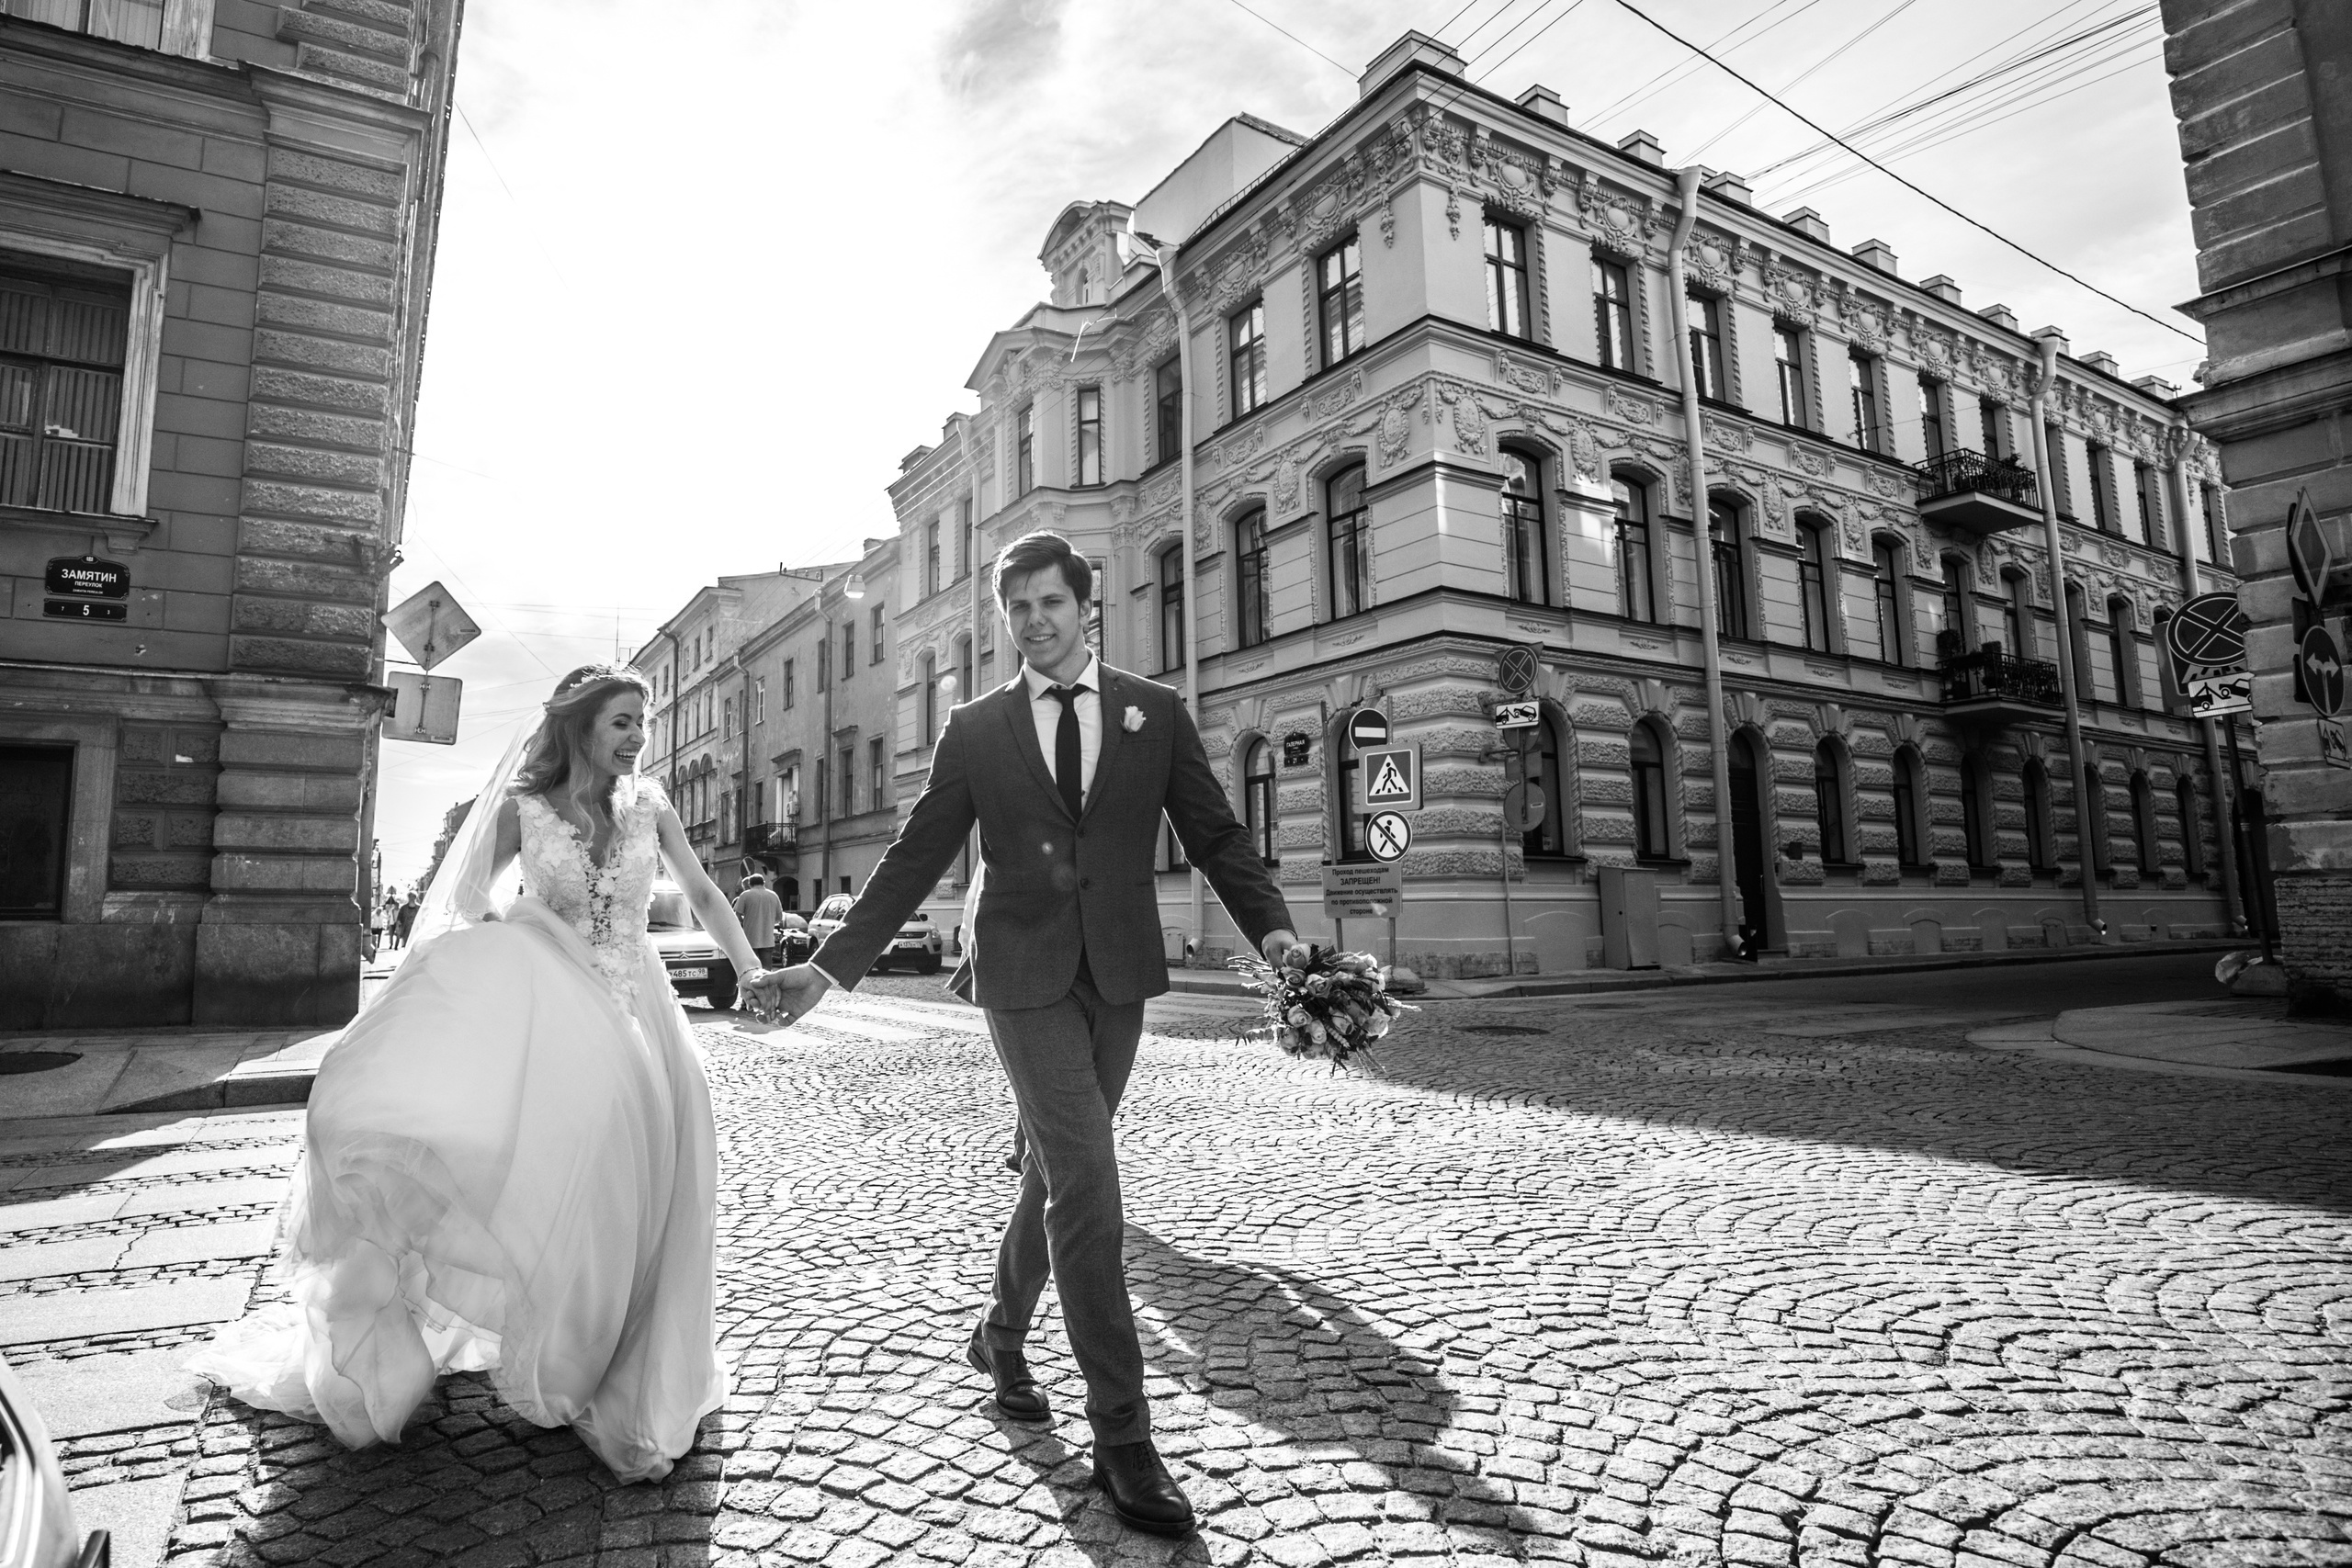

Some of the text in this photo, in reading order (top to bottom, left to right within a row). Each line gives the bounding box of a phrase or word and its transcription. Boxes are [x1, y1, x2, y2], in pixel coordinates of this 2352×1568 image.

[61, 569, 117, 582] ЗАМЯТИН
[83, 604, 90, 615] 5
[1331, 868, 1354, 876] Проход
[1340, 876, 1381, 886] ЗАПРЕЩЕН!
[1326, 887, 1398, 897] Движение осуществлять
